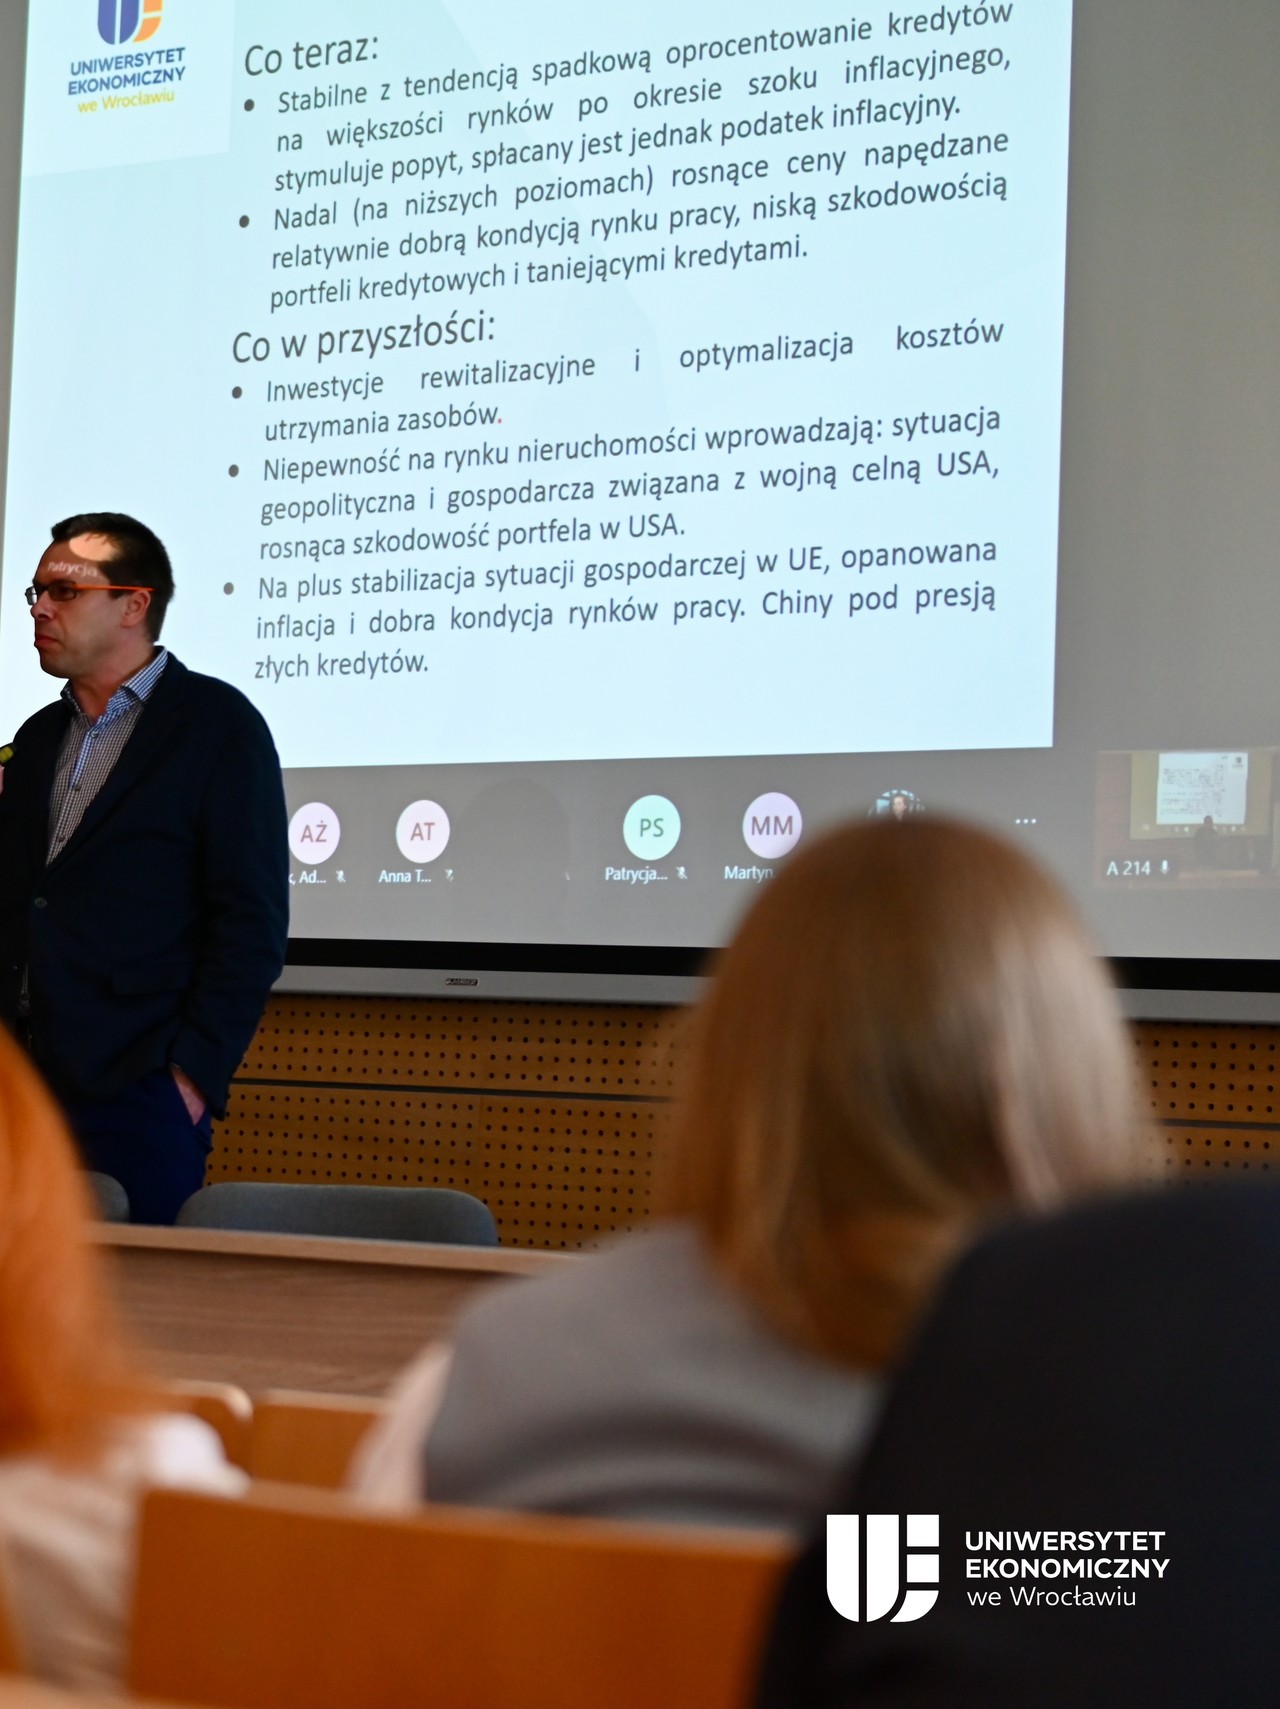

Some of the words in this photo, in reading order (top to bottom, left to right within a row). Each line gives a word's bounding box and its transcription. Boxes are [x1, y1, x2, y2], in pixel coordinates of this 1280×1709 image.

[68, 66, 186, 96] EKONOMICZNY
[70, 46, 186, 76] UNIWERSYTET
[244, 44, 283, 77] Co
[292, 36, 379, 71] teraz:
[277, 83, 368, 114] Stabilne
[380, 82, 391, 102] z
[403, 62, 518, 98] tendencją
[531, 49, 652, 87] spadkową
[665, 16, 873, 69] oprocentowanie
[888, 0, 1014, 38] kredytów
[78, 100, 98, 113] we
[102, 88, 176, 110] Wrocławiu
[277, 133, 303, 153] na
[326, 109, 444, 149] większości
[467, 97, 555, 135] rynków
[578, 95, 609, 123] po
[633, 77, 723, 110] okresie
[748, 65, 818, 96] szoku
[845, 47, 1011, 85] inflacyjnego,
[274, 158, 384, 195] stymuluje
[391, 150, 464, 185] popyt,
[471, 139, 574, 174] spłacany
[578, 130, 624, 163] jest
[628, 117, 713, 158] jednak
[720, 104, 825, 147] podatek
[832, 93, 961, 129] inflacyjny.
[274, 200, 338, 231] Nadal
[353, 196, 388, 228] (na
[405, 183, 498, 217] niższych
[514, 164, 654, 211] poziomach)
[671, 159, 769, 188] rosnące
[786, 150, 847, 177] ceny
[864, 132, 1009, 170] napędzane
[272, 236, 390, 271] relatywnie
[398, 229, 466, 257] dobrą
[476, 216, 580, 249] kondycją
[590, 207, 658, 242] rynku
[669, 204, 741, 235] pracy,
[752, 191, 817, 221] niską
[827, 171, 1008, 213] szkodowością
[270, 277, 352, 315] portfeli
[358, 262, 506, 301] kredytowych
[514, 261, 519, 286] i
[526, 246, 666, 285] taniejącymi
[674, 233, 808, 271] kredytami.
[232, 331, 271, 364] Co
[280, 333, 308, 359] w
[317, 308, 495, 365] przyszłości:
[267, 371, 384, 403] Inwestycje
[420, 354, 596, 390] rewitalizacyjne
[634, 348, 640, 373] i
[679, 330, 854, 374] optymalizacja
[896, 317, 1005, 351] kosztów
[263, 446, 401, 485] Niepewność
[408, 451, 435, 471] na
[444, 440, 509, 474] rynku
[517, 426, 696, 464] nieruchomości
[704, 414, 883, 455] wprowadzają:
[891, 405, 1001, 443] sytuacja
[265, 410, 390, 445] utrzymania
[396, 400, 503, 432] zasobów.
[260, 491, 416, 527] geopolityczna
[429, 486, 435, 510] i
[446, 478, 595, 515] gospodarcza
[608, 471, 720, 502] związana
[733, 471, 746, 491] z
[759, 461, 837, 493] wojną
[851, 454, 921, 485] celną
[937, 449, 999, 480] USA,
[260, 537, 346, 563] rosnąca
[352, 521, 490, 555] szkodowość
[497, 516, 592, 553] portfela
[599, 520, 621, 541] w
[628, 512, 686, 539] USA.
[258, 576, 288, 600] Na
[297, 572, 343, 604] plus
[351, 565, 476, 596] stabilizacja
[484, 559, 575, 593] sytuacji
[583, 549, 746, 589] gospodarczej
[755, 553, 779, 573] w
[788, 545, 830, 576] UE,
[841, 541, 997, 575] opanowana
[256, 613, 336, 643] inflacja
[349, 611, 355, 635] i
[368, 608, 436, 634] dobra
[450, 602, 554, 634] kondycja
[568, 595, 659, 630] rynków
[673, 597, 746, 626] pracy.
[761, 588, 834, 620] Chiny
[848, 583, 899, 618] pod
[915, 580, 996, 615] presją
[254, 654, 311, 684] złych
[317, 647, 429, 681] kredytów.
[300, 820, 328, 843] AŻ
[409, 821, 436, 842] AT
[639, 817, 665, 838] PS
[750, 815, 794, 836] MM
[378, 869, 412, 883] Anna
[1106, 861, 1119, 876] A
[1122, 861, 1151, 876] 214
